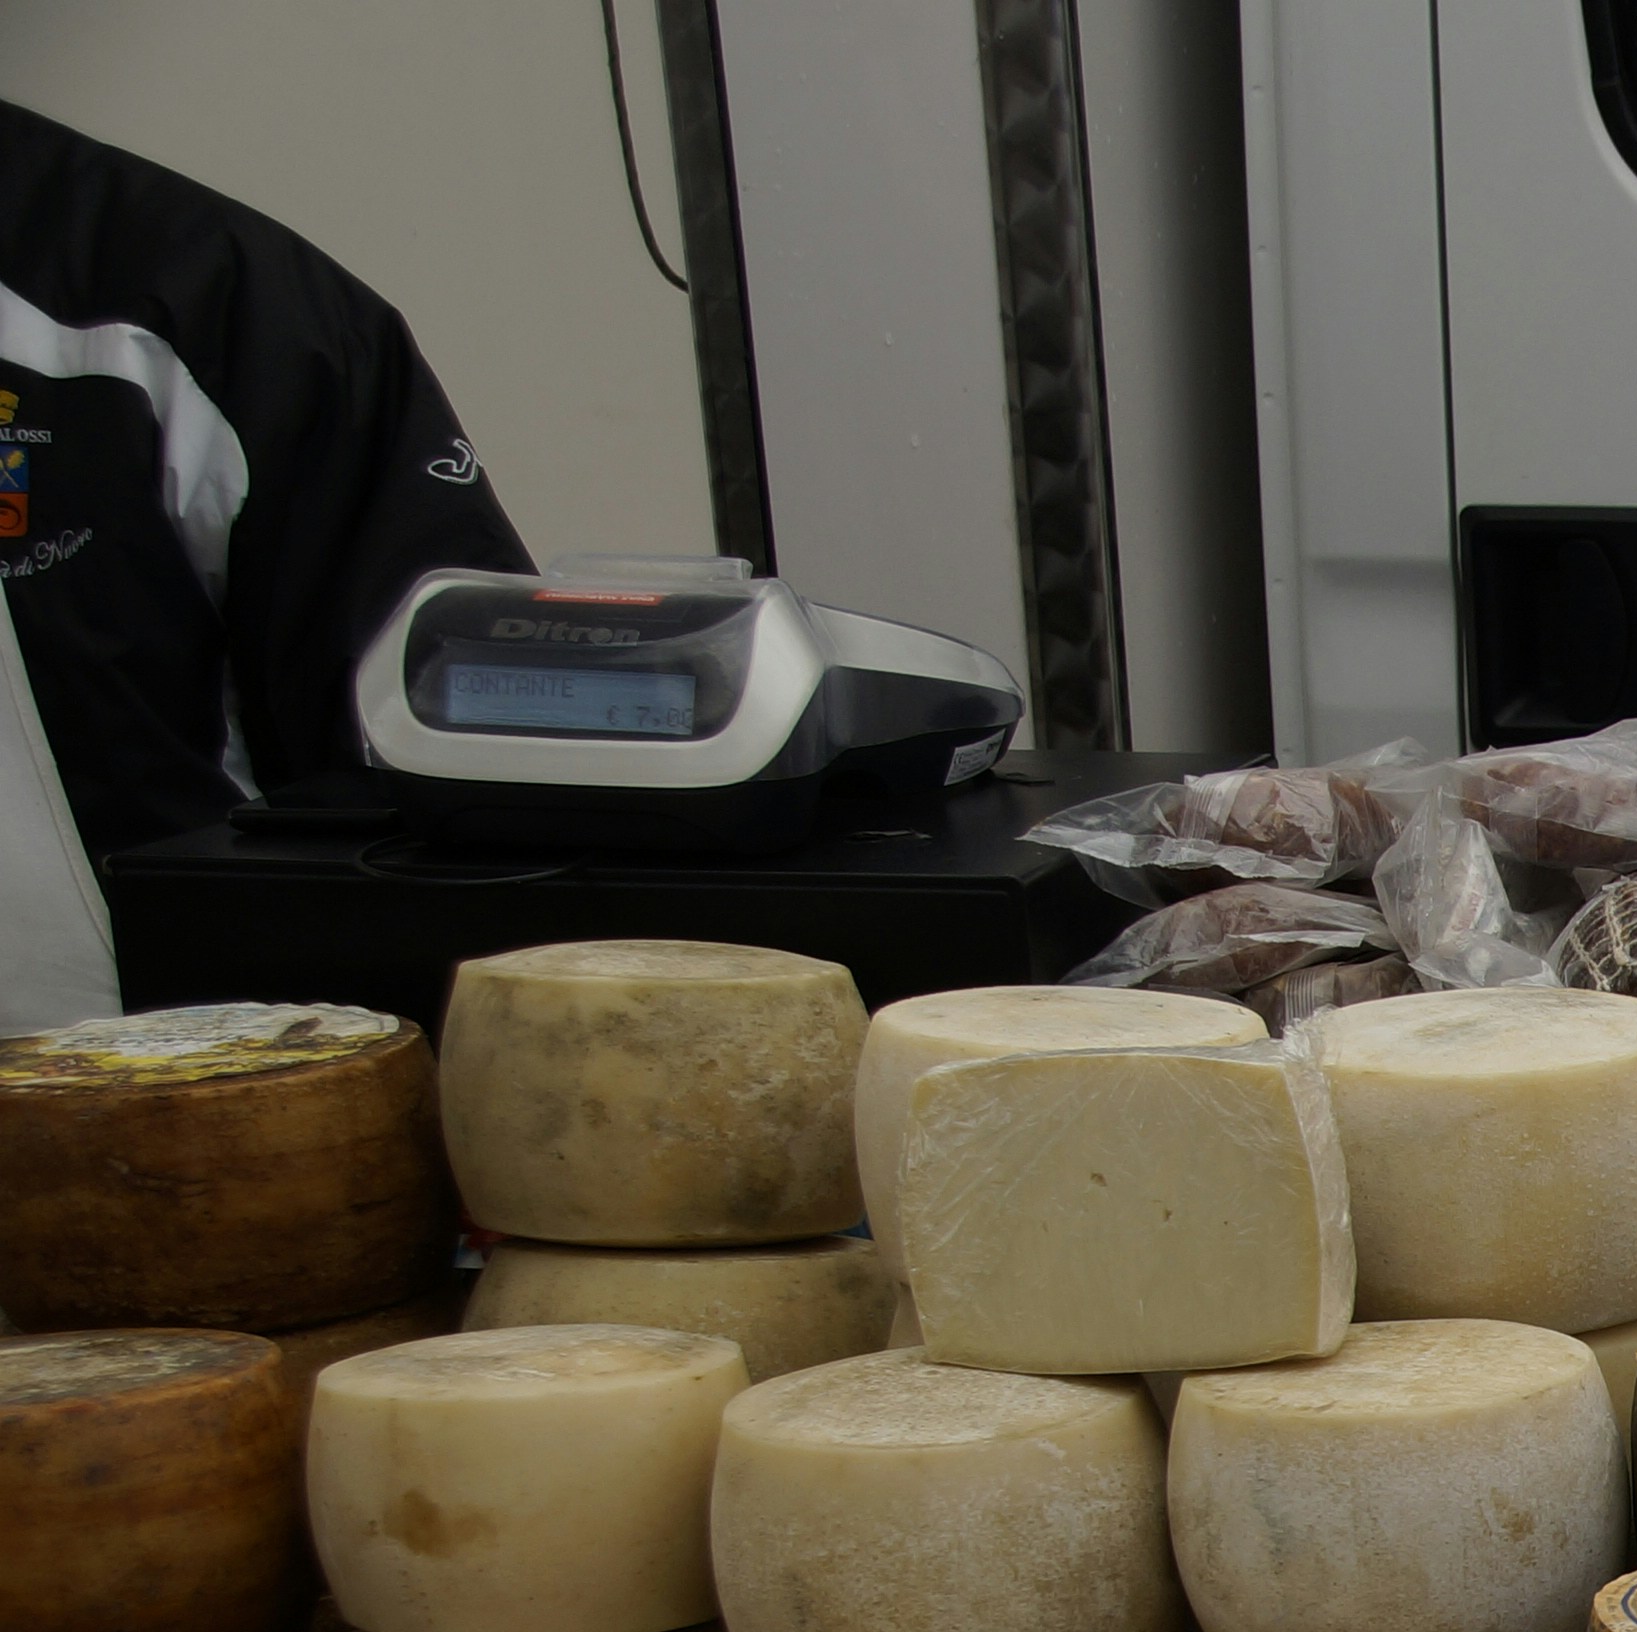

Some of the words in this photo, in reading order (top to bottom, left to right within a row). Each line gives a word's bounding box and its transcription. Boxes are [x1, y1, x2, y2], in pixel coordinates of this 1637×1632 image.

[17, 429, 52, 443] OSSI
[490, 617, 640, 647] Ditron
[453, 673, 576, 699] CONTANTE
